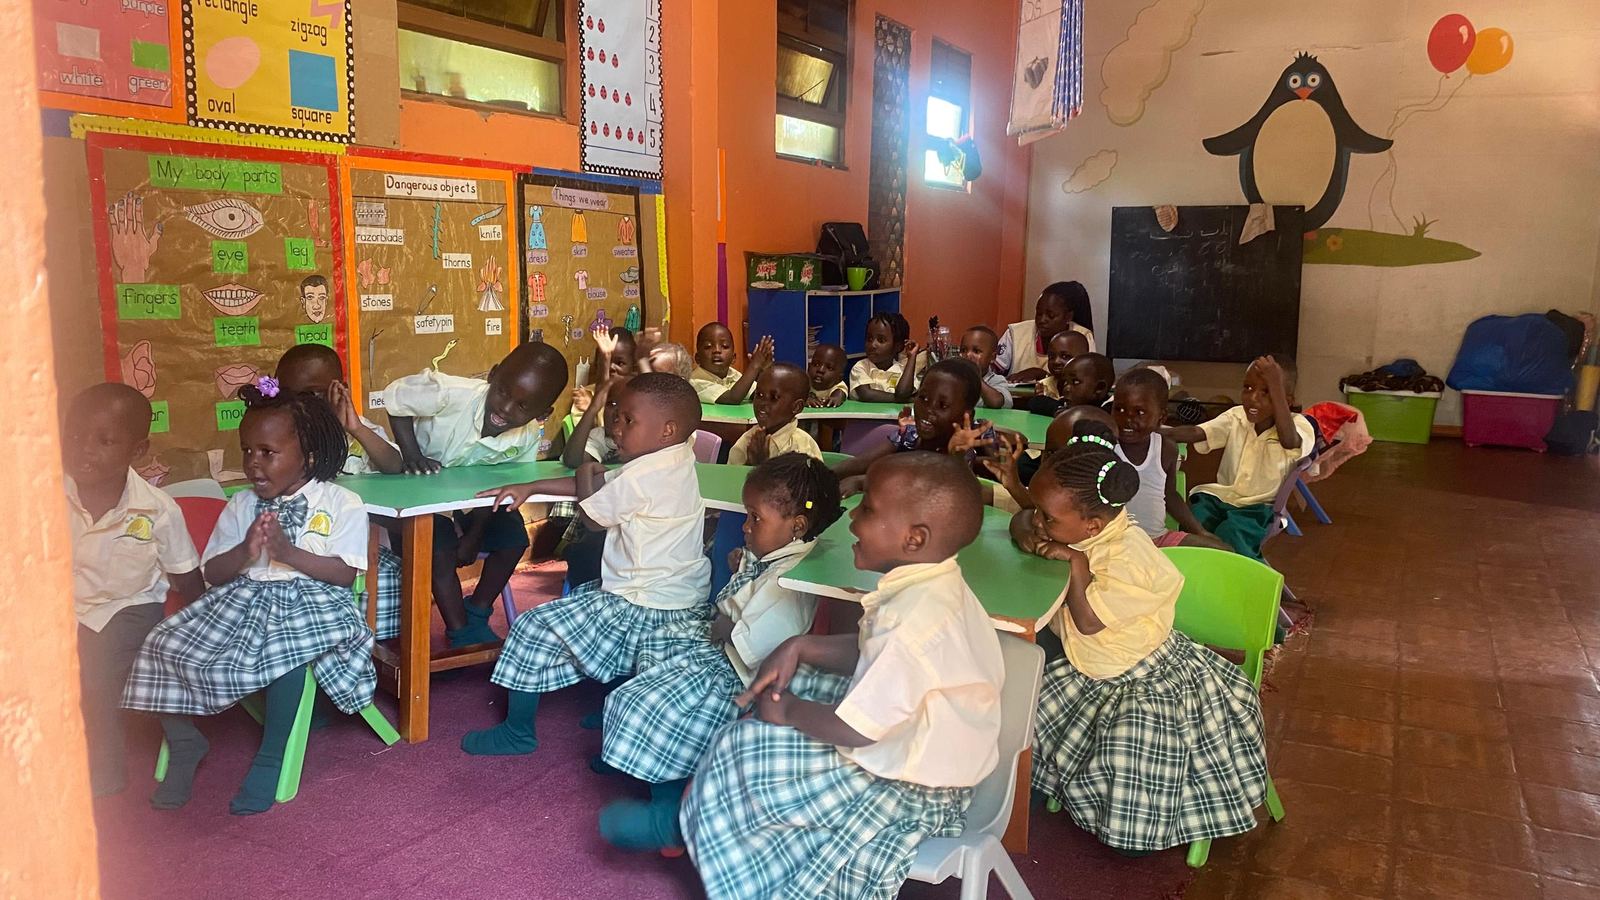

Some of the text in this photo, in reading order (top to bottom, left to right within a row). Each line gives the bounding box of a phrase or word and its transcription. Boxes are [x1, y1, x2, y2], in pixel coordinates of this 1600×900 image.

[290, 18, 328, 47] zigzag
[649, 26, 655, 43] 2
[649, 54, 655, 75] 3
[60, 65, 104, 86] white
[128, 75, 168, 95] green
[207, 92, 236, 114] oval
[649, 92, 656, 116] 4
[291, 107, 332, 128] square
[649, 128, 656, 149] 5
[156, 160, 277, 192] My body parts
[386, 175, 476, 197] Dangerous objects
[554, 188, 607, 208] Things we wear
[355, 229, 403, 243] razorblade
[479, 227, 501, 239] knife
[217, 248, 244, 271] eye
[289, 241, 309, 267] leg
[443, 255, 471, 268] thorns
[528, 253, 547, 264] dress
[122, 288, 178, 314] fingers
[362, 296, 391, 308] stones
[220, 320, 256, 338] teeth
[416, 316, 453, 332] safetypin
[486, 319, 500, 332] fire
[298, 328, 328, 343] head
[371, 396, 385, 406] nee
[151, 409, 164, 422] ar
